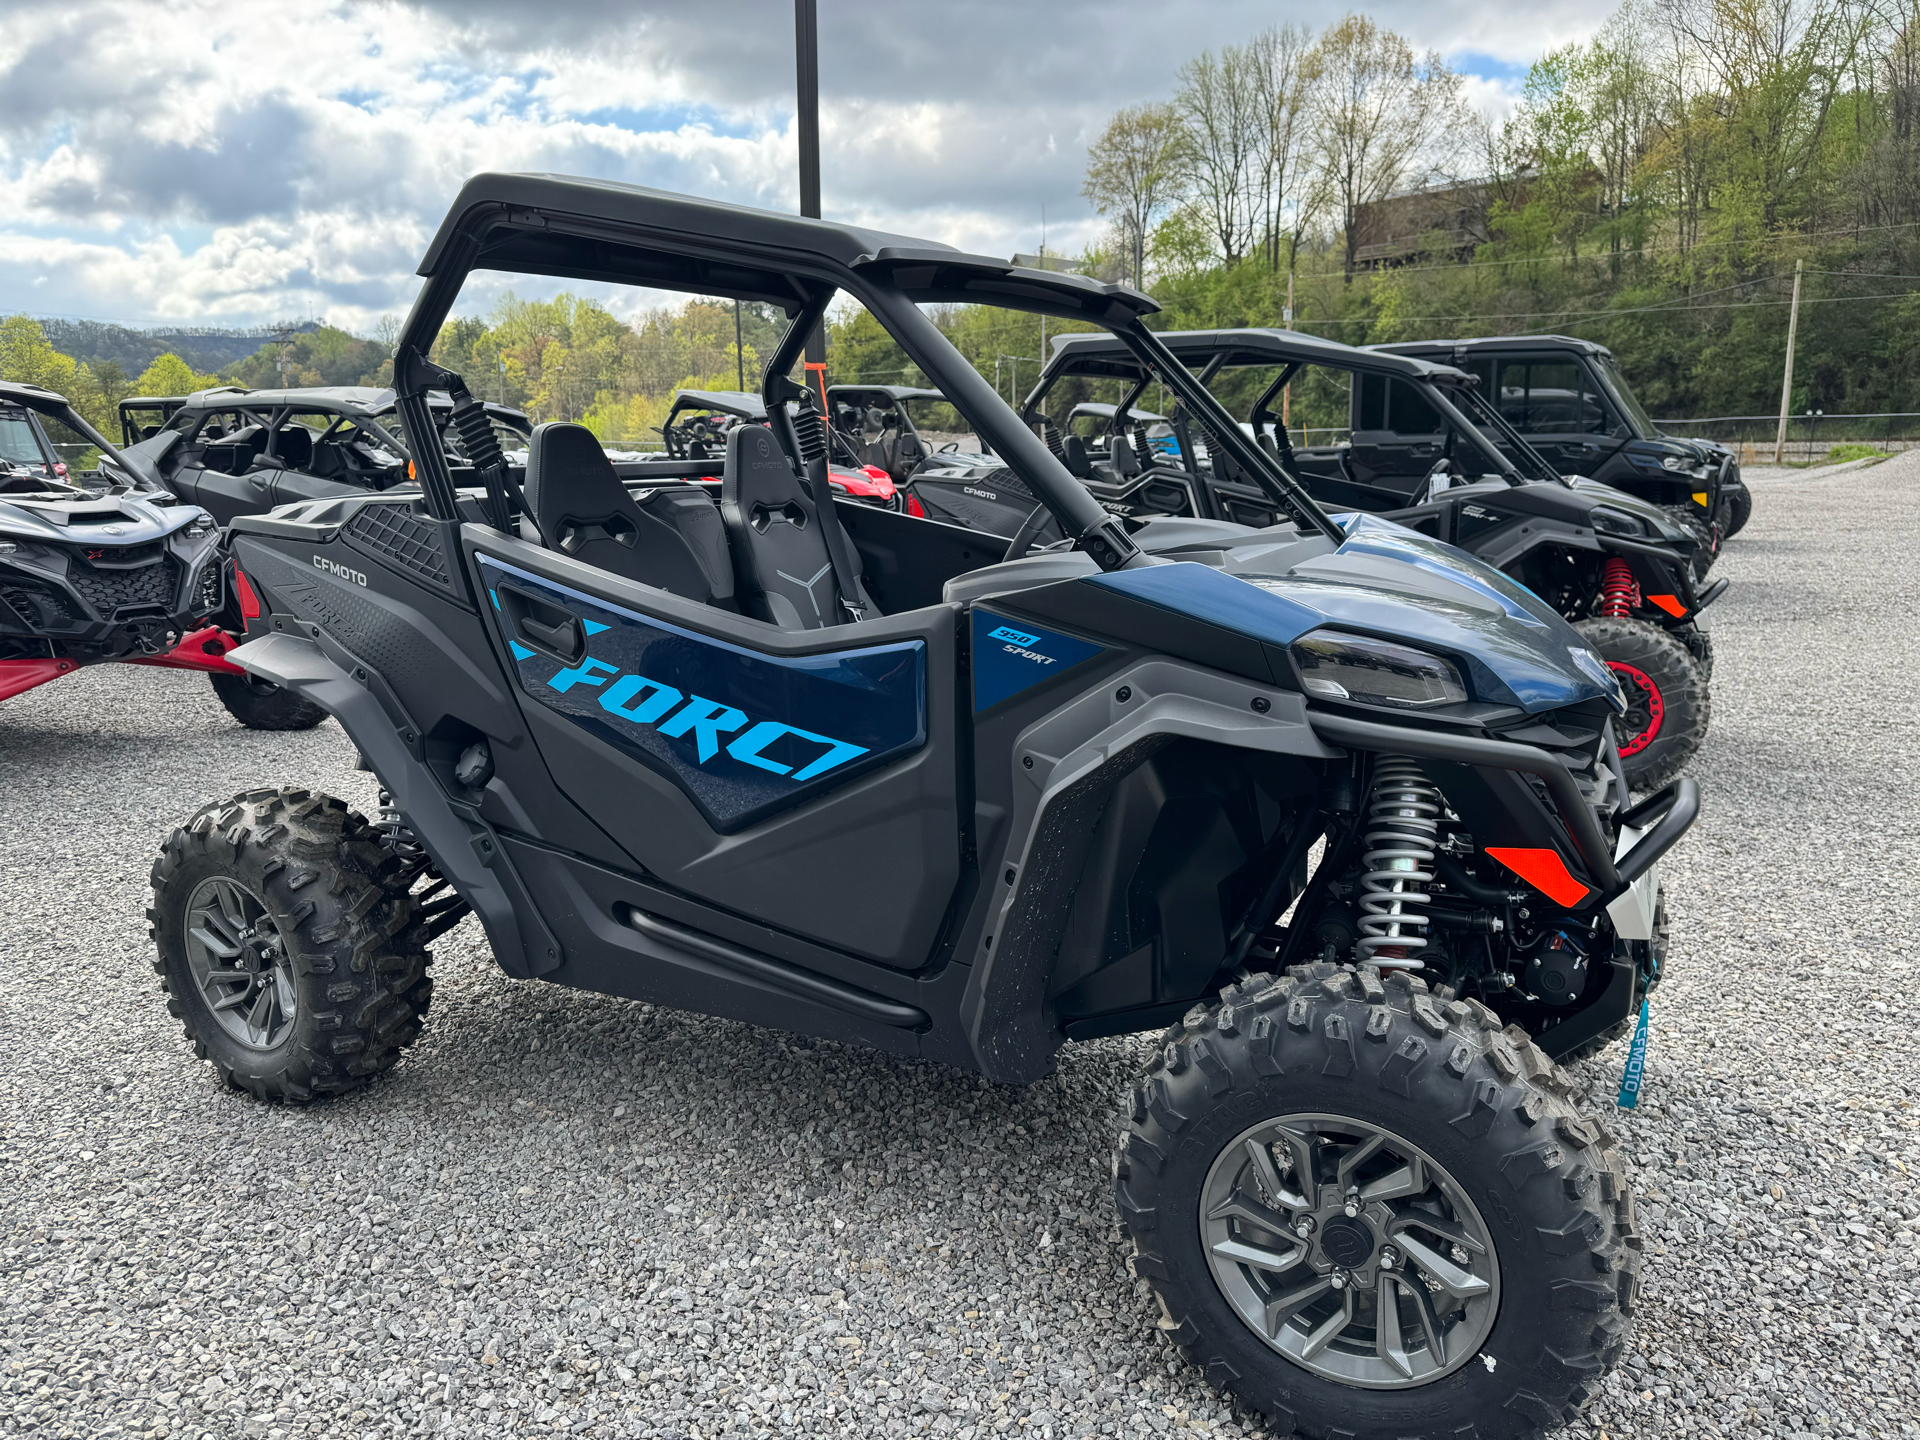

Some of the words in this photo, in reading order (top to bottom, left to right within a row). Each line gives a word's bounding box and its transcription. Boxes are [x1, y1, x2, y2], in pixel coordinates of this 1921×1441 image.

[752, 461, 783, 471] CFMOTO
[963, 486, 997, 500] CFMOTO
[313, 555, 367, 587] CFMOTO
[997, 629, 1032, 643] 950
[1002, 644, 1057, 665] SPORT
[1624, 1026, 1648, 1093] CFMOTO
